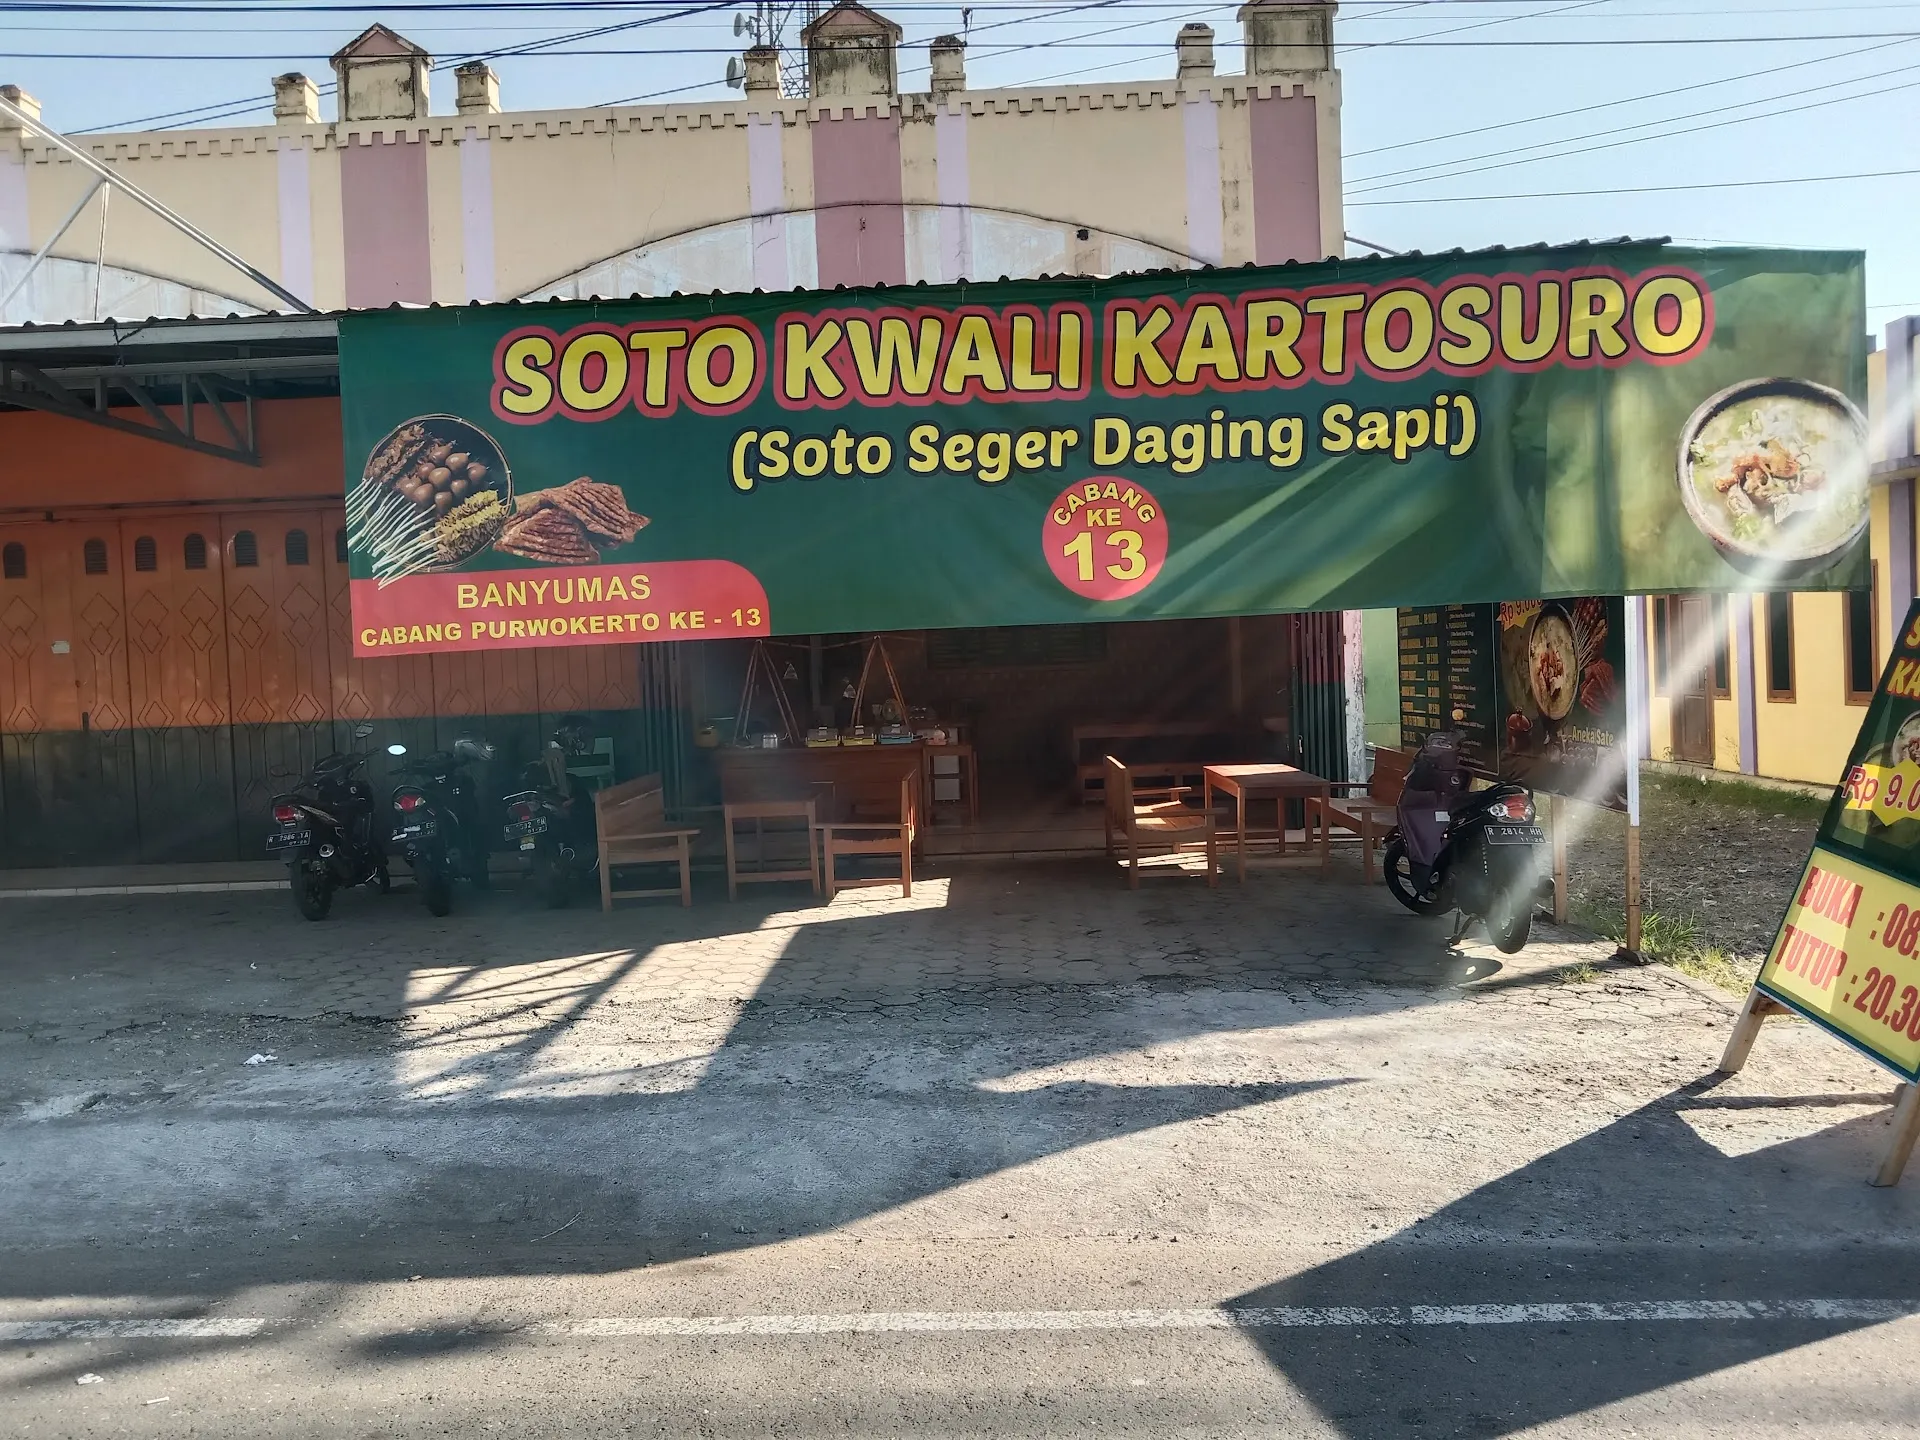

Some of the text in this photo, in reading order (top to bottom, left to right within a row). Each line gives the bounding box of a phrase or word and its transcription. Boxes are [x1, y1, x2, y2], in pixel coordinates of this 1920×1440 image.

[502, 275, 1704, 414] SOTO KWALI KARTOSURO
[733, 394, 1476, 489] (Soto Seger Daging Sapi)
[1053, 482, 1156, 525] CABANG
[1086, 508, 1122, 527] KE
[1063, 530, 1147, 581] 13
[458, 575, 650, 608] BANYUMAS
[360, 622, 462, 647] CABANG
[471, 613, 659, 638] PURWOKERTO
[669, 610, 705, 630] KE
[731, 608, 761, 627] 13
[1501, 602, 1513, 625] Rp
[1572, 726, 1614, 746] Aneka Sate
[1841, 766, 1879, 809] Rp
[1487, 827, 1543, 836] R 2814 HH
[1797, 866, 1864, 929] BUKA
[1774, 923, 1848, 991] TUTUP
